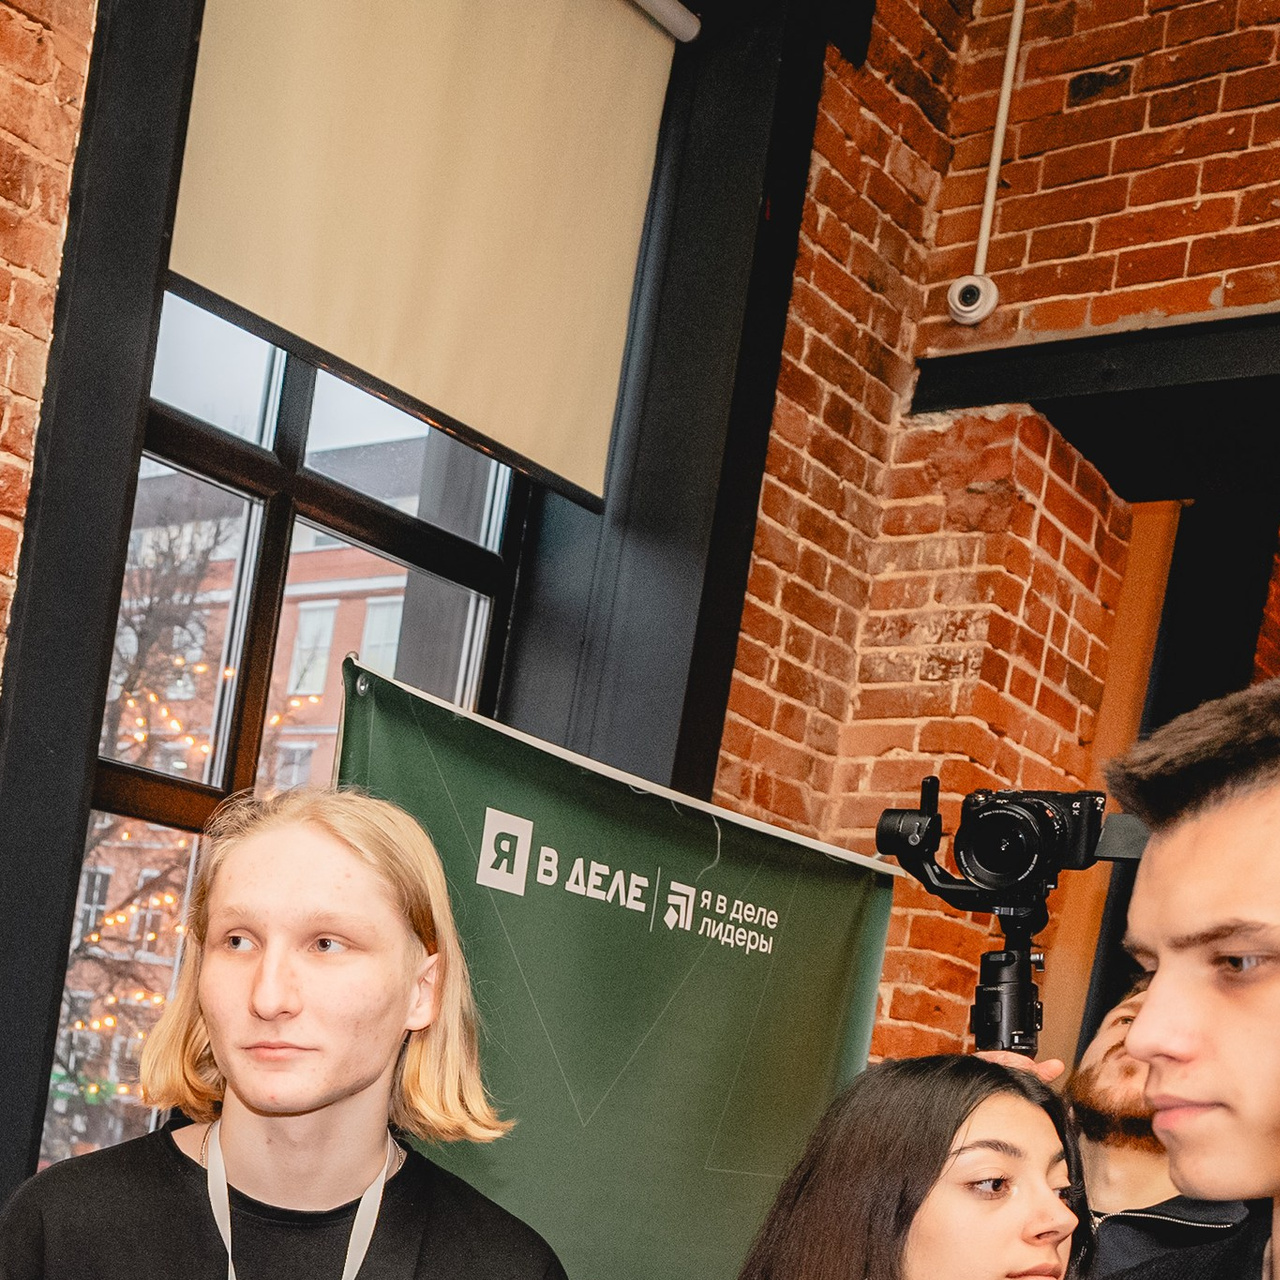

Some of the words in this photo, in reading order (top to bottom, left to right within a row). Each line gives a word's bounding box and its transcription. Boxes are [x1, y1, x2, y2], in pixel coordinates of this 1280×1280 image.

[536, 846, 559, 886] В
[565, 858, 649, 912] ДЕЛЕ
[730, 899, 779, 930] деле
[698, 917, 773, 955] лидеры
